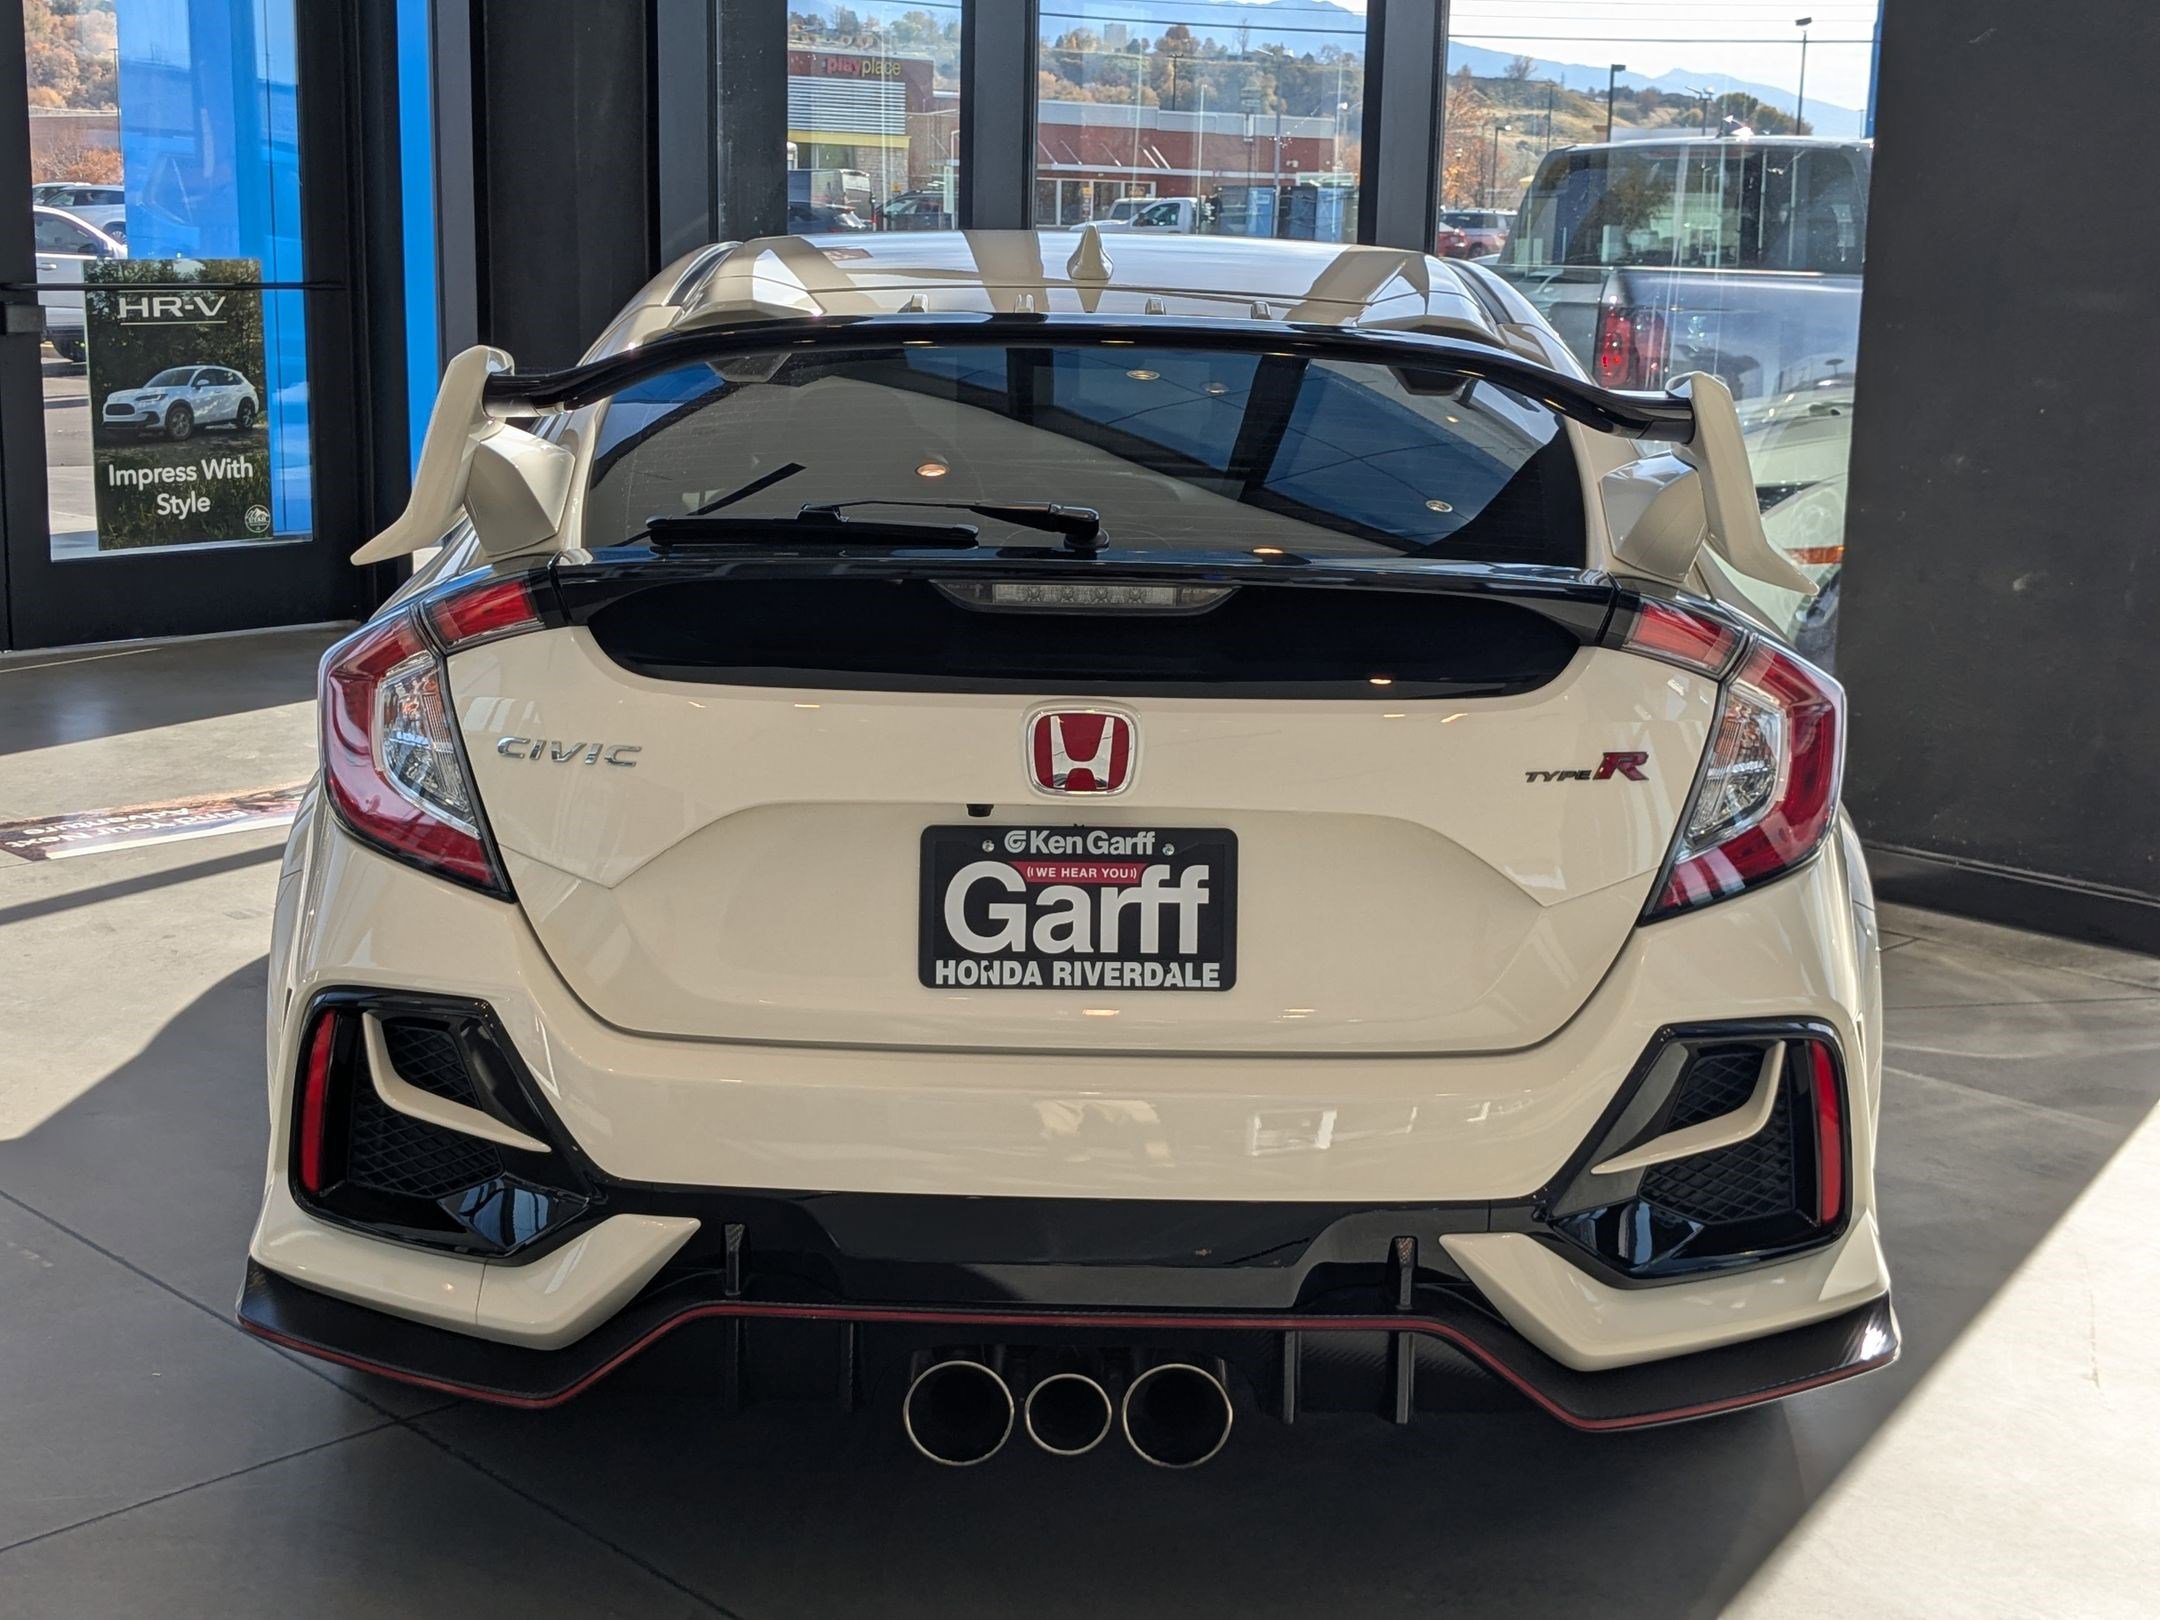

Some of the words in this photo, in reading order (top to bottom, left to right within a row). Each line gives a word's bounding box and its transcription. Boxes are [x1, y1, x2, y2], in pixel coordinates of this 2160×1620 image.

[119, 296, 227, 318] HR-V
[108, 462, 198, 489] Impress
[201, 456, 254, 481] With
[156, 492, 212, 520] Style
[497, 735, 643, 767] CIVIC
[1525, 769, 1593, 783] TYPE
[1592, 751, 1650, 782] R
[22, 807, 190, 835] Adventure
[96, 820, 177, 836] Your
[173, 809, 249, 825] Find
[4, 831, 93, 849] Next
[1030, 830, 1083, 854] Ken
[1086, 831, 1156, 855] Garff
[1061, 867, 1098, 879] HEAR
[944, 860, 1210, 954] Garff
[935, 959, 1044, 986] HONDA
[1052, 960, 1221, 988] RIVERDALE
